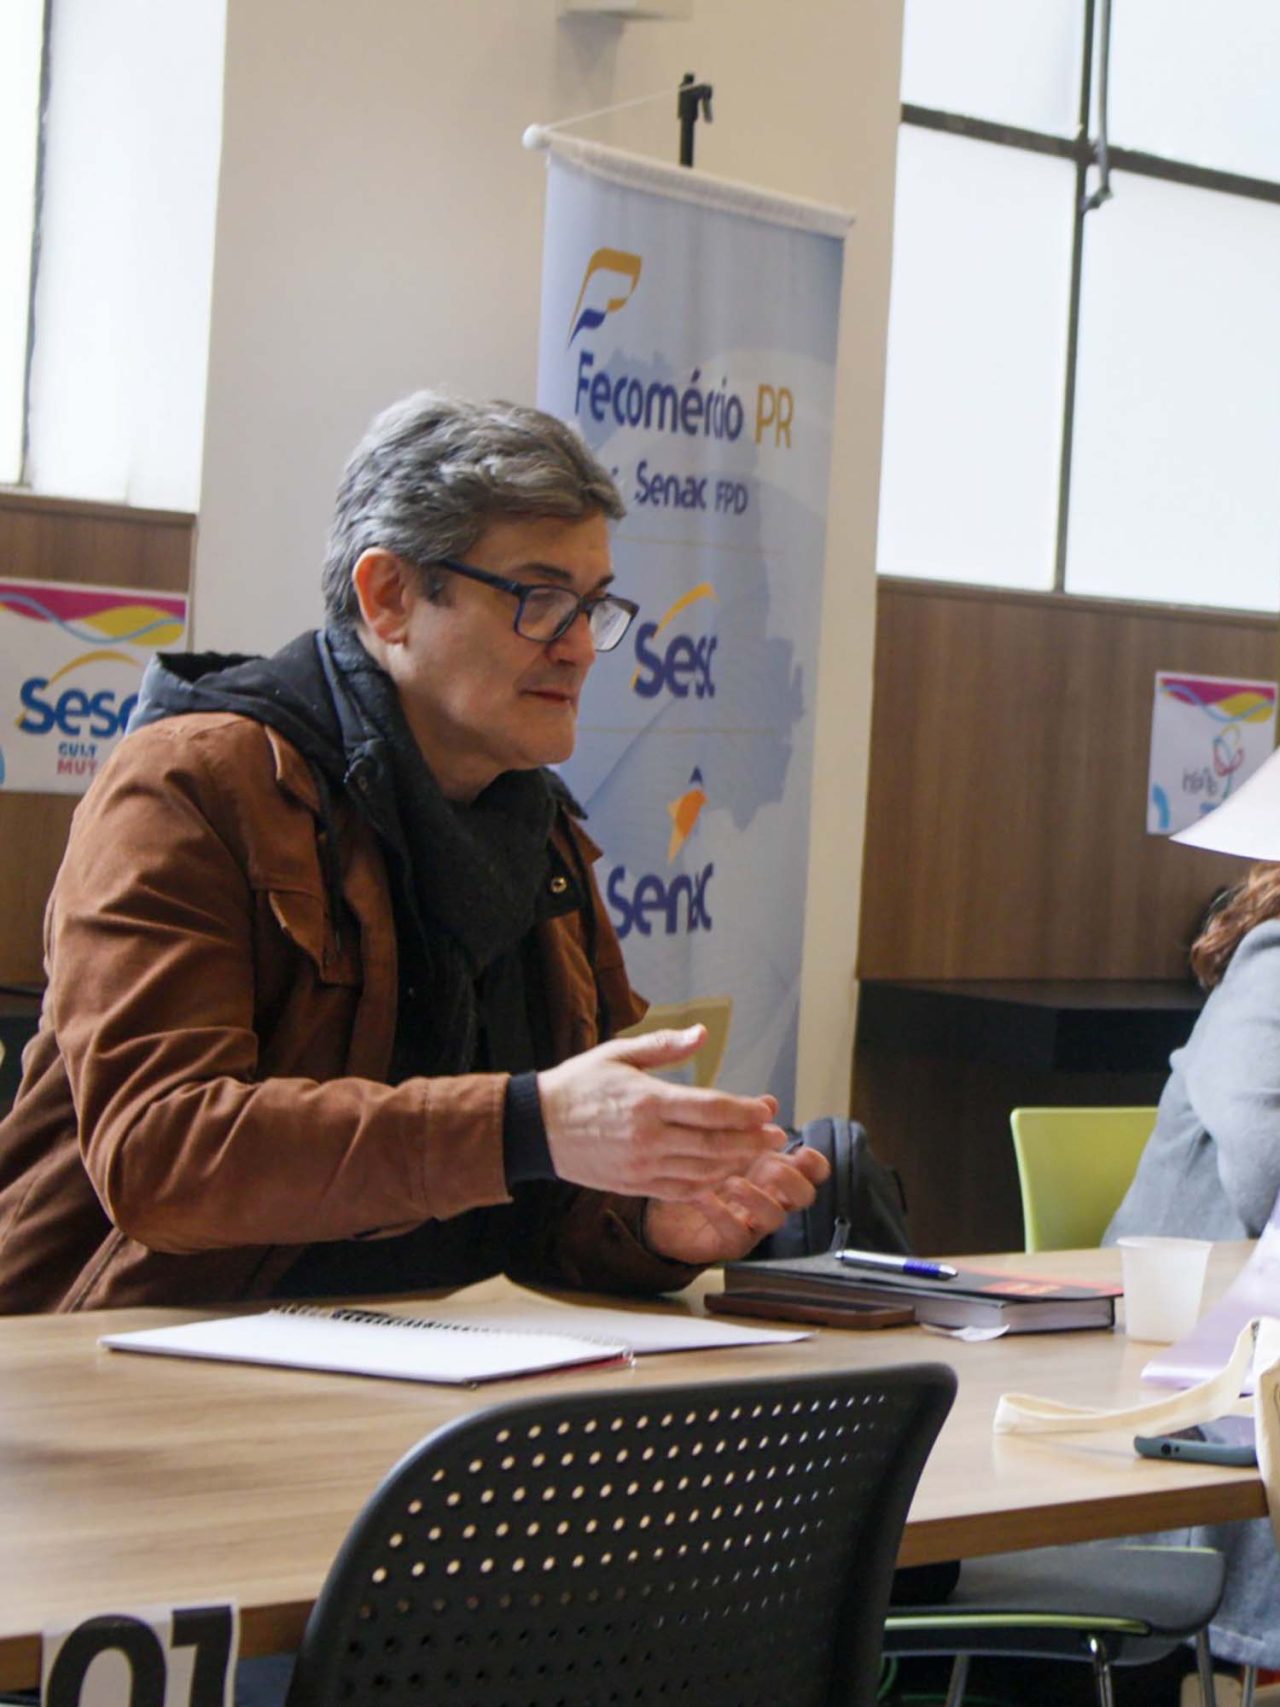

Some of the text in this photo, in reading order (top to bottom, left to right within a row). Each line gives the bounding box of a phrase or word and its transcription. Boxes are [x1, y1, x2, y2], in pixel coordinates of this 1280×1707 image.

[575, 350, 795, 449] Fecomércio PR
[635, 461, 708, 509] Senac
